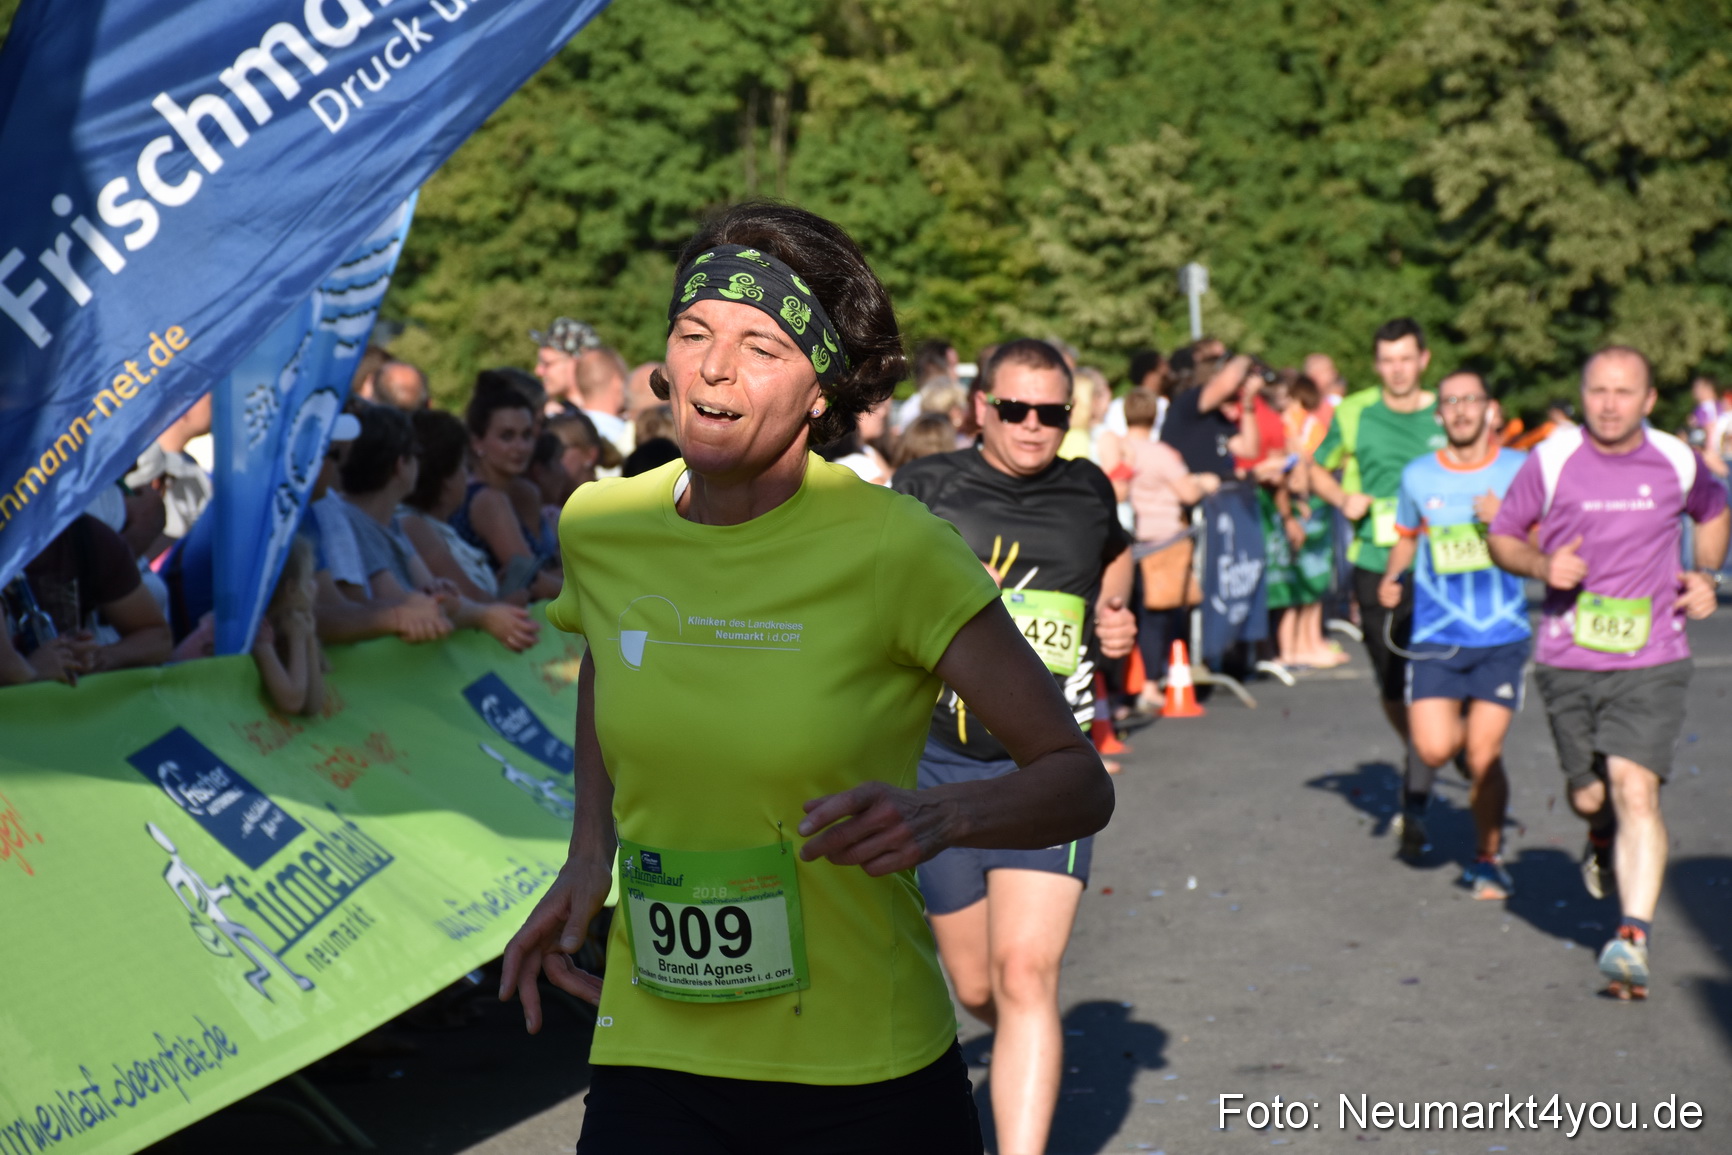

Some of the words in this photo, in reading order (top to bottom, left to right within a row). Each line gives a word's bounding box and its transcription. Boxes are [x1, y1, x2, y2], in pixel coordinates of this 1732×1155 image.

[308, 16, 433, 134] Druck
[429, 0, 477, 22] u
[0, 0, 392, 349] Frischma
[0, 325, 190, 530] hmann-net.de
[687, 616, 726, 627] Kliniken
[729, 618, 746, 628] des
[748, 619, 803, 630] Landkreises
[715, 630, 764, 642] Neumarkt
[1012, 617, 1072, 650] 425
[1592, 615, 1636, 638] 682
[224, 802, 393, 946] firmenlauf
[634, 866, 684, 887] firmenlauf
[692, 887, 727, 899] 2018
[305, 902, 376, 973] neumarkt
[649, 902, 752, 960] 909
[658, 958, 699, 976] Brandl
[703, 963, 753, 979] Agnes
[658, 973, 668, 983] des
[669, 976, 712, 987] Landkreises
[714, 975, 756, 987] Neumarkt
[765, 972, 773, 981] d.
[775, 967, 794, 979] OPf.
[0, 1014, 238, 1155] irmenlauf-oberpfalz.de
